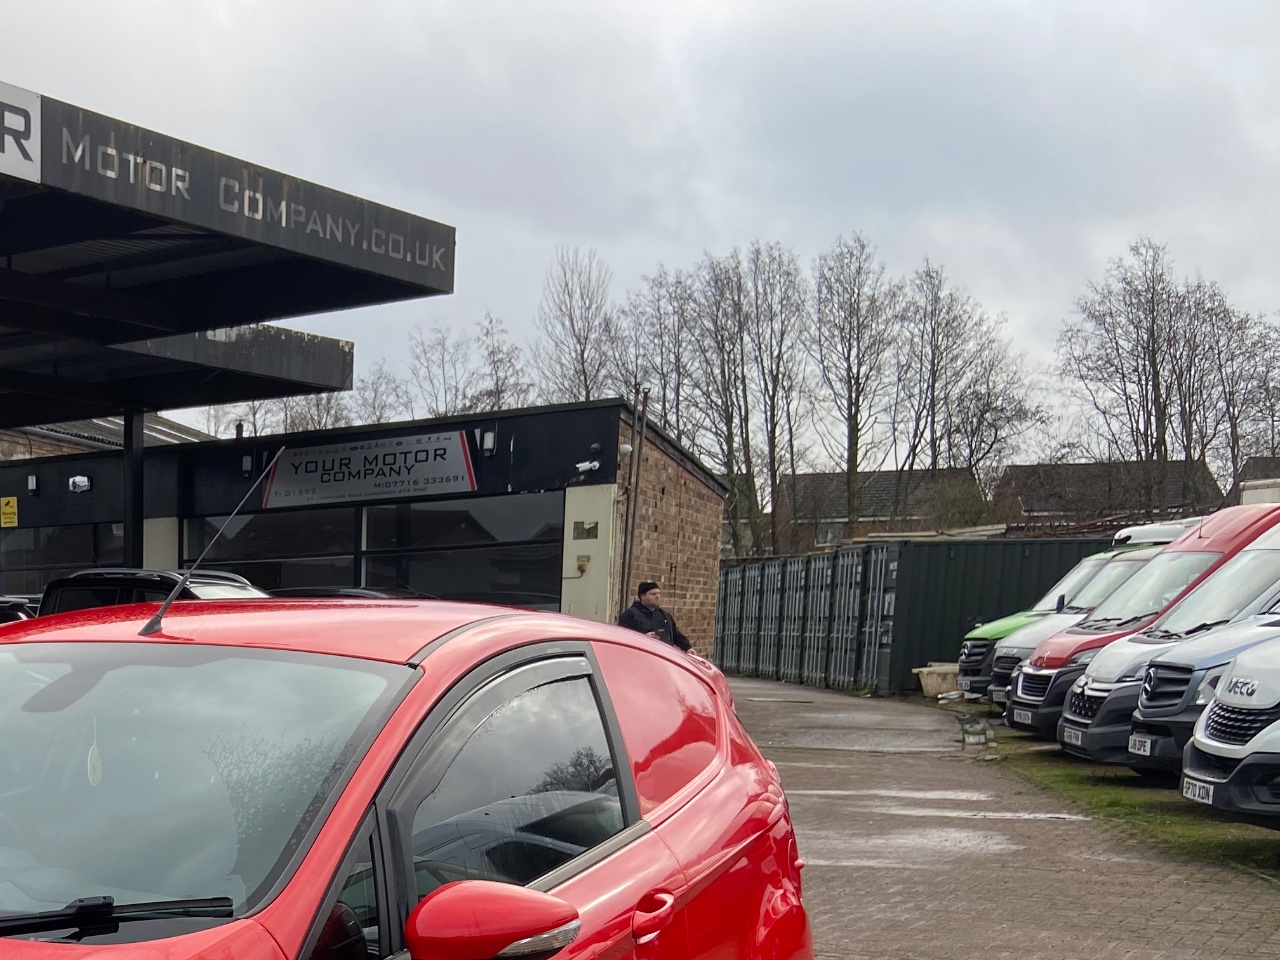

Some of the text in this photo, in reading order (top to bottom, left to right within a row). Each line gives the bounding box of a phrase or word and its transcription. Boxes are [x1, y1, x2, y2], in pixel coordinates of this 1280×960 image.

[62, 127, 191, 201] MOTOR
[290, 447, 448, 475] YOUR MOTOR
[320, 464, 416, 484] COMPANY
